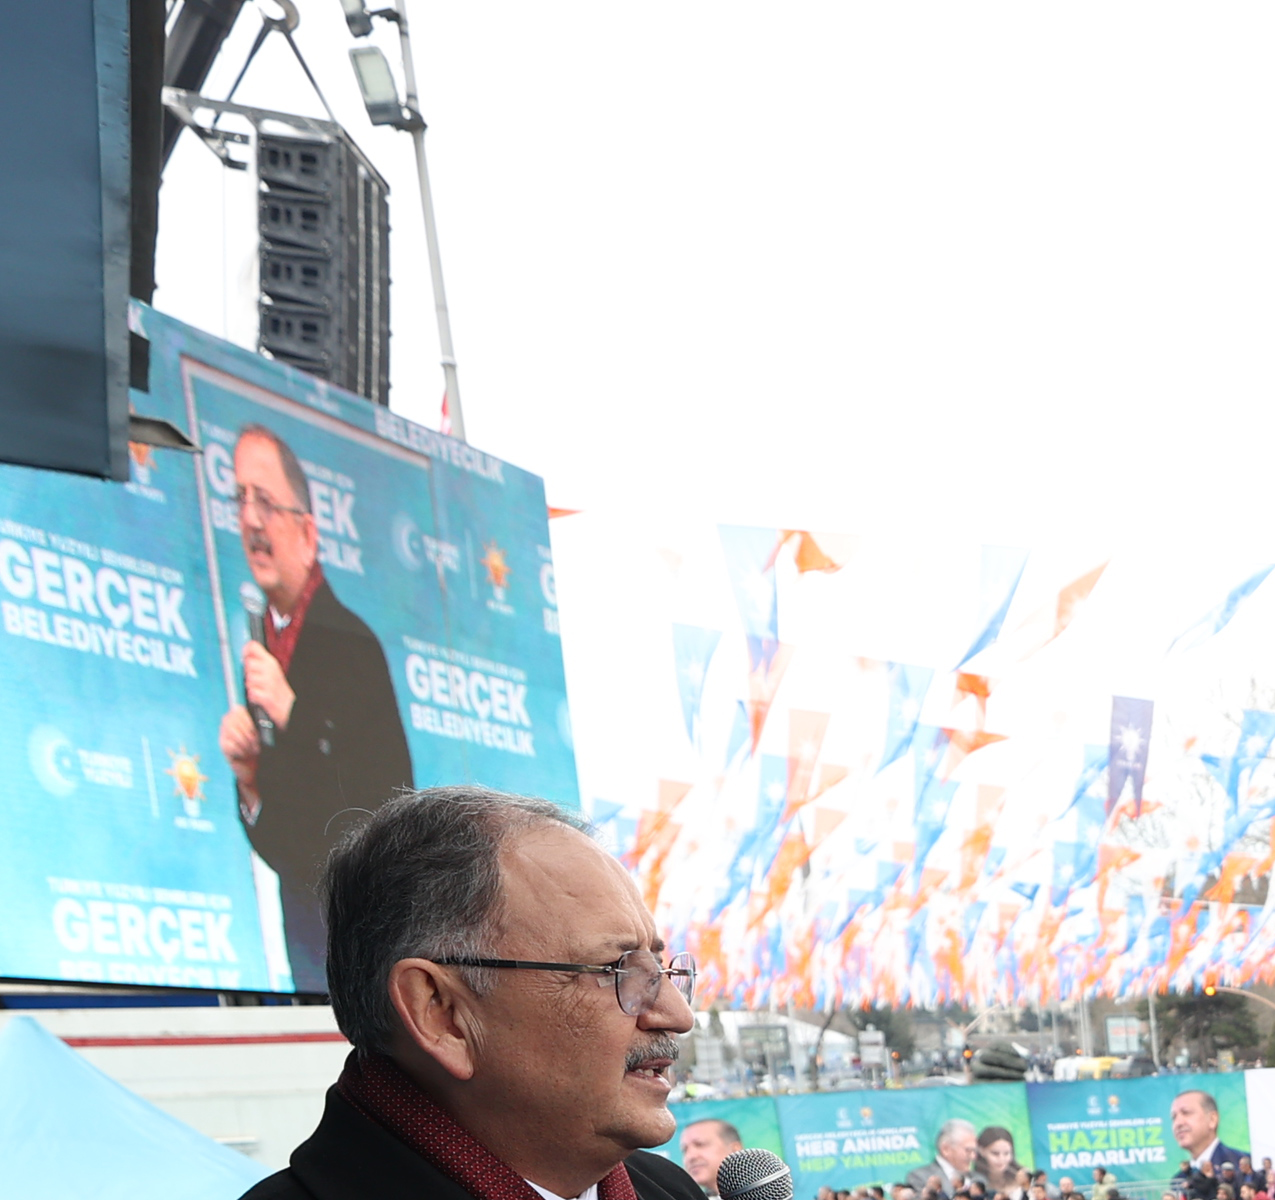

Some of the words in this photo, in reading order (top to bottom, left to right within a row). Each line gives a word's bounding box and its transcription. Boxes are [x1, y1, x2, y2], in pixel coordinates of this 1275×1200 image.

[0, 538, 192, 641] GERÇEK
[2, 601, 199, 679] BELEDİYECİLİK
[405, 653, 533, 728] GERÇEK
[409, 702, 537, 758] BELEDİYECİLİK
[52, 896, 238, 965] GERÇEK
[795, 1139, 838, 1157] HER
[842, 1134, 920, 1154] ANINDA
[799, 1156, 837, 1172] HEP
[841, 1150, 921, 1169] YANINDA
[1049, 1126, 1163, 1152] HAZIRIZ
[1050, 1146, 1166, 1169] KARARLIYIZ
